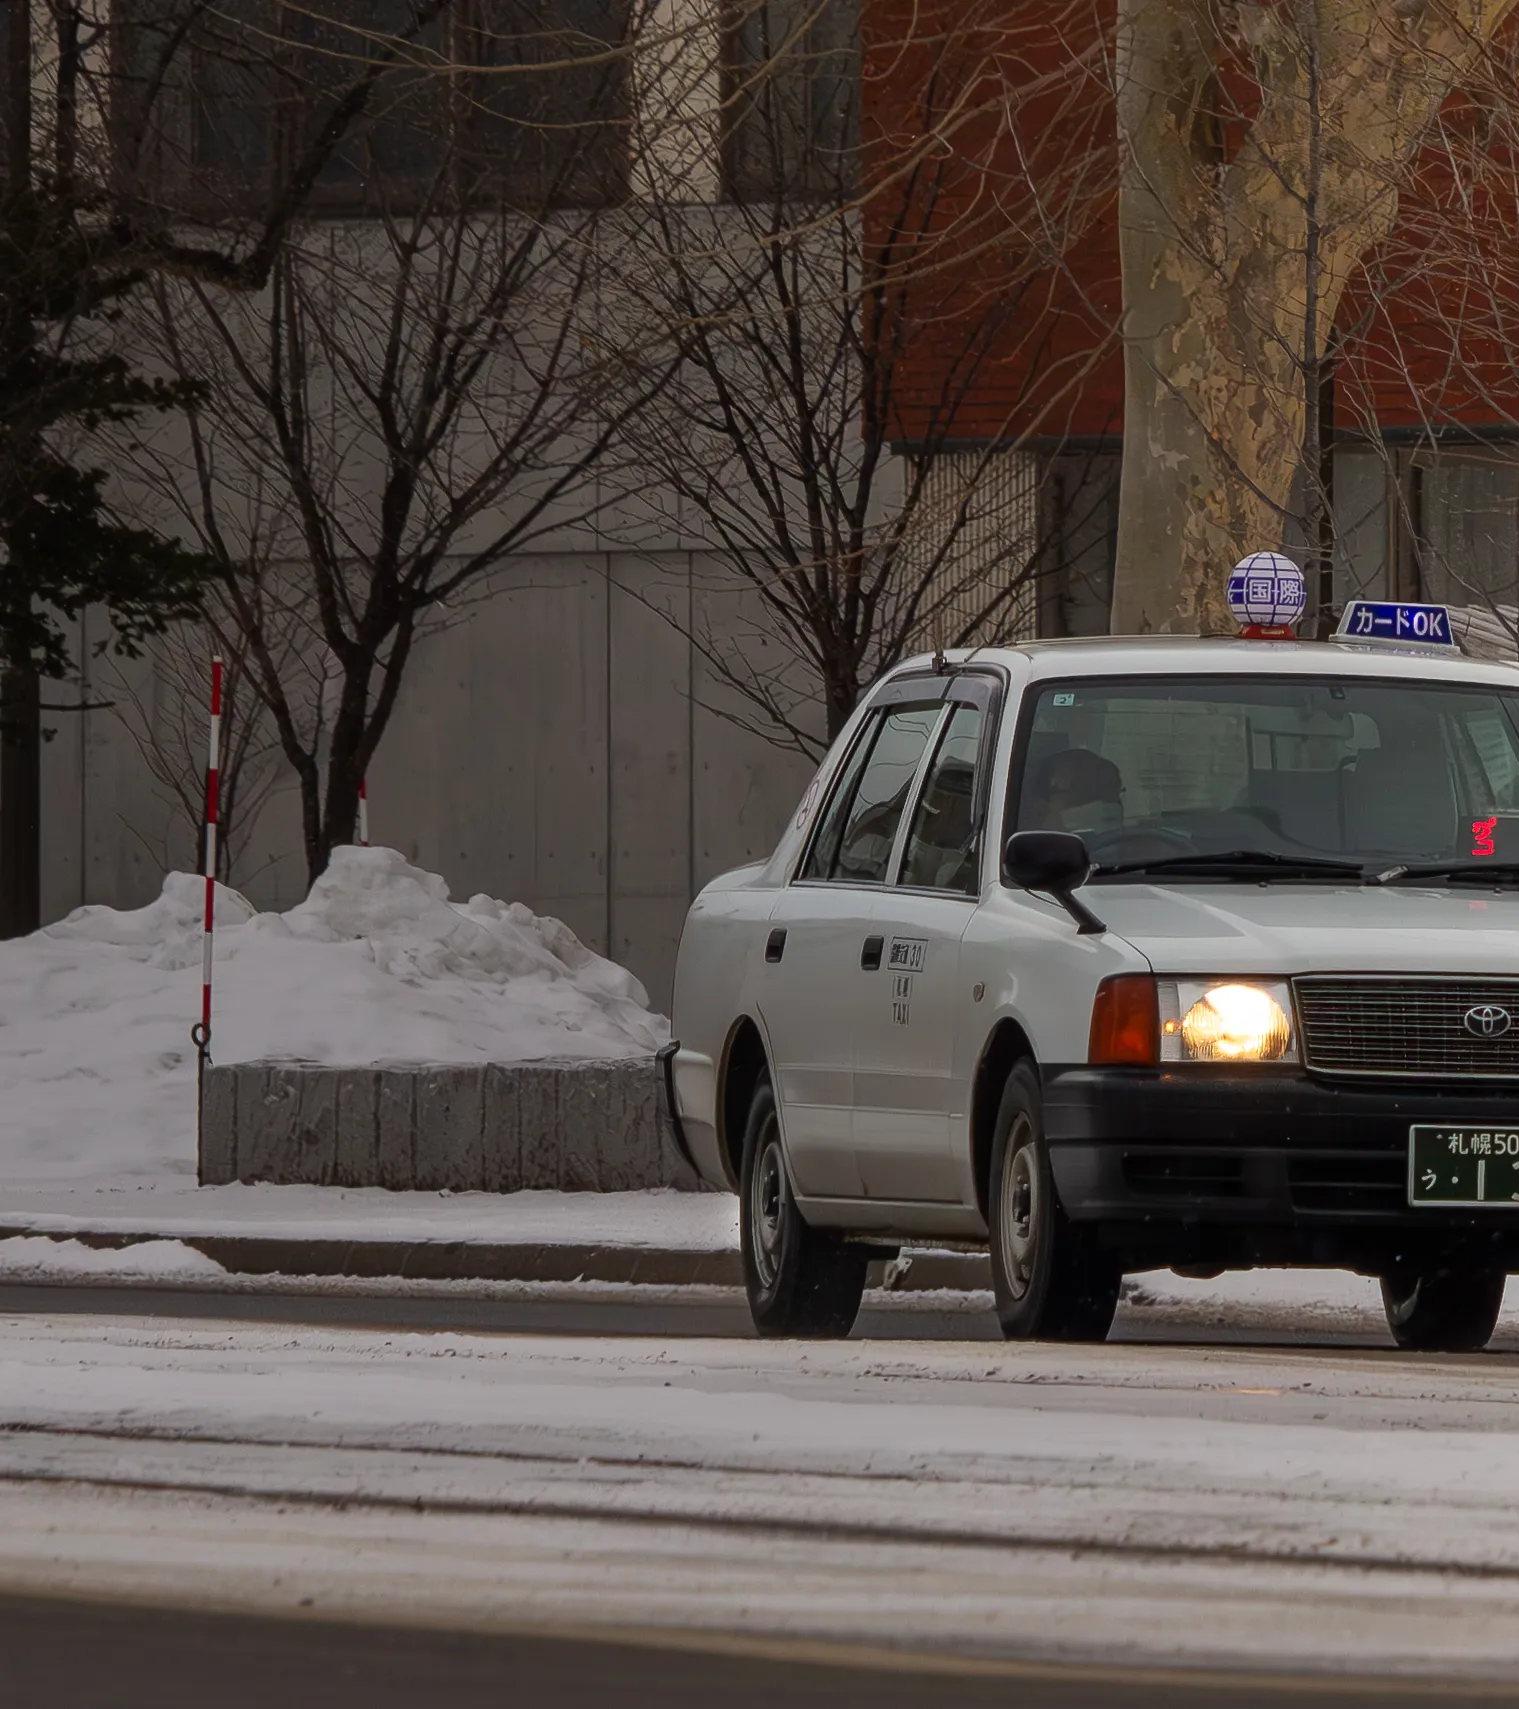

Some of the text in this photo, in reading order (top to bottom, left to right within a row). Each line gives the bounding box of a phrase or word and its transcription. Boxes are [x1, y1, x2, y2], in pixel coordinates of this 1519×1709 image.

[1249, 580, 1300, 604] 国際
[1356, 608, 1443, 637] カードOK
